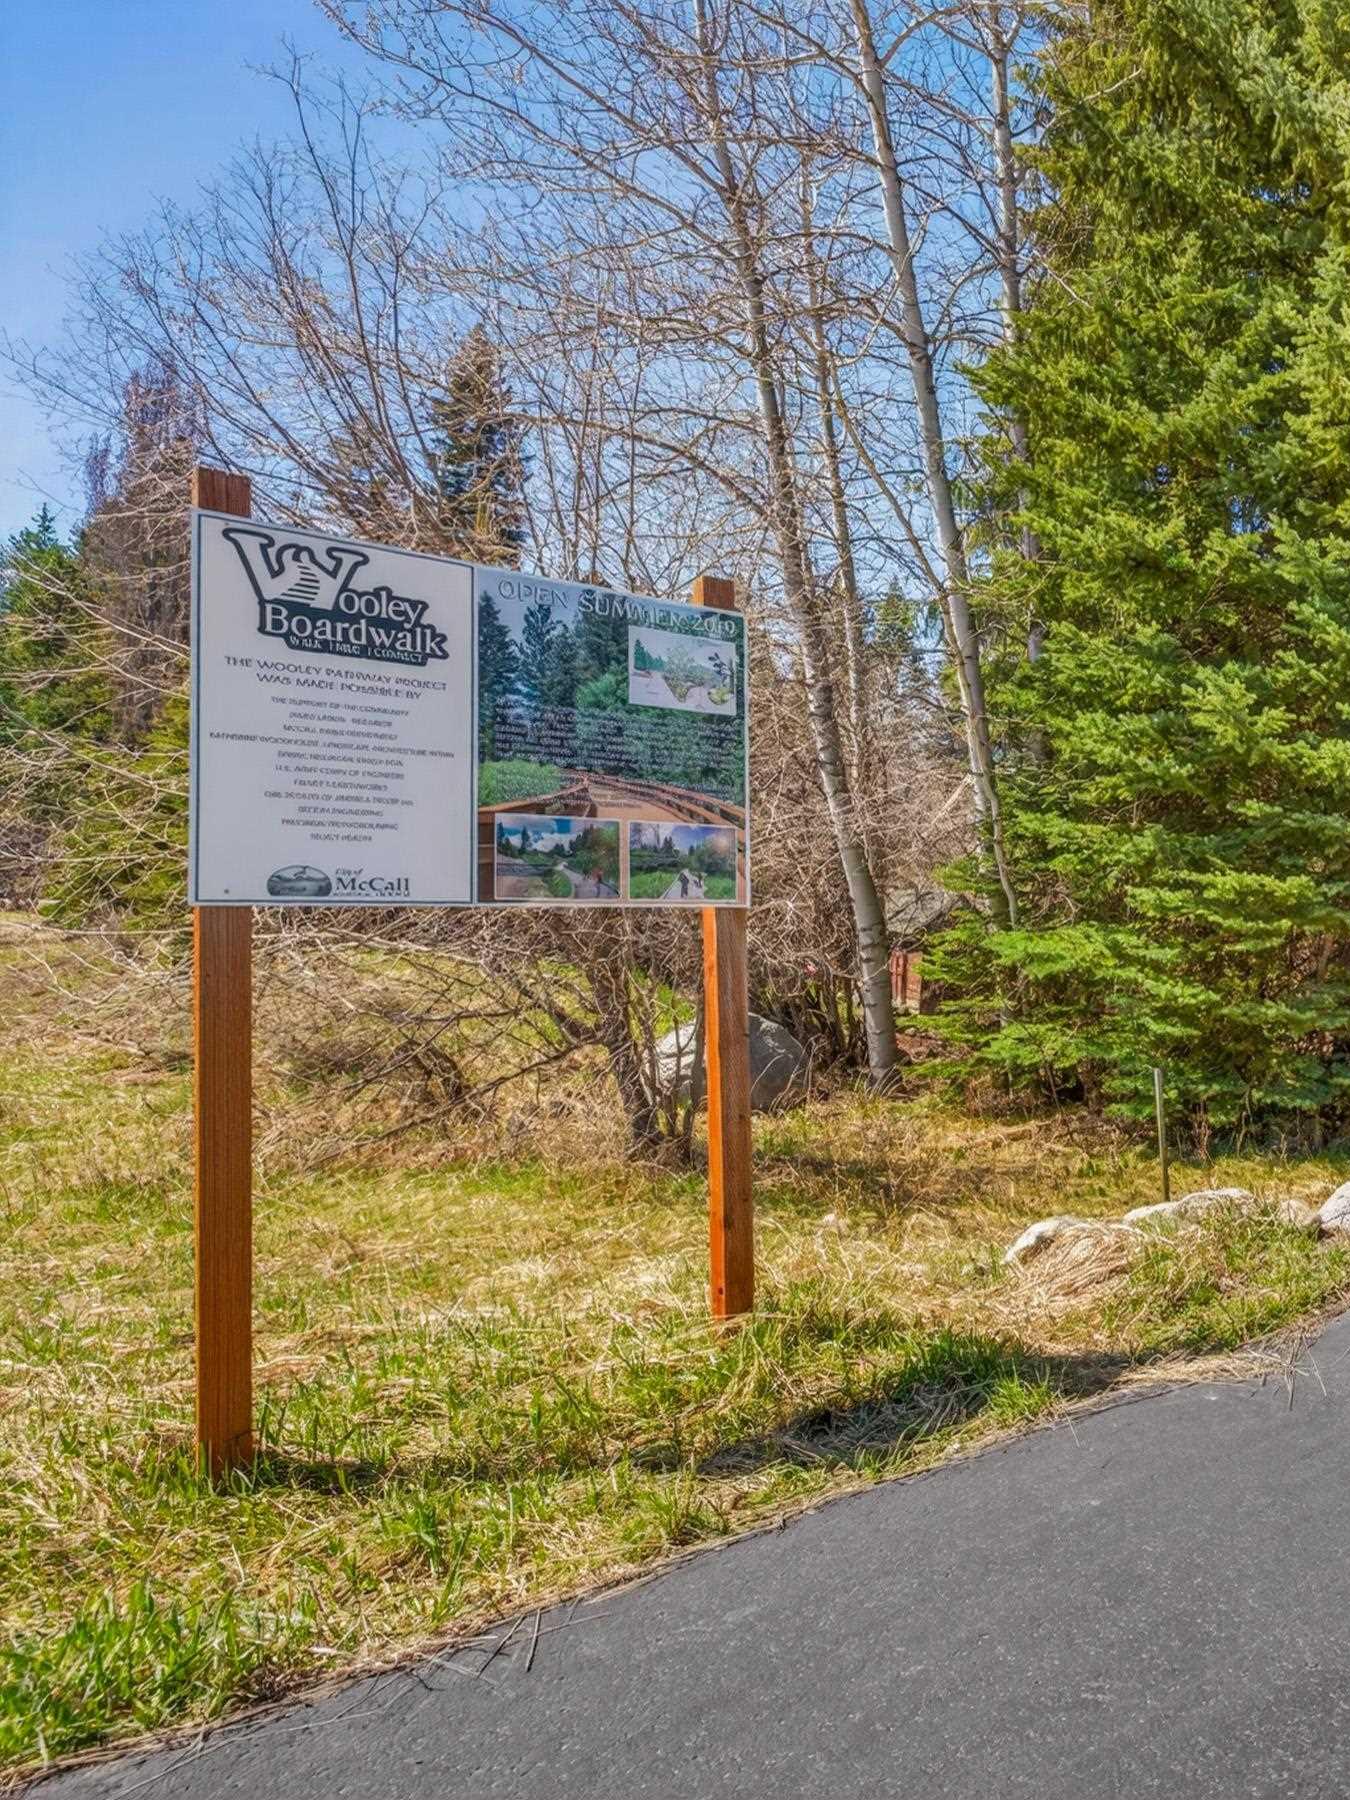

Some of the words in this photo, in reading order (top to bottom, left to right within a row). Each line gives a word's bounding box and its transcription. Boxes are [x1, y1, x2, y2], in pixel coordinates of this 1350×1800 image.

[222, 527, 424, 630] Wooley
[498, 579, 569, 609] OPEN
[264, 602, 447, 657] Boardwalk
[224, 655, 253, 668] THE
[256, 659, 323, 676] WOOLEY
[256, 672, 292, 686] WAS
[295, 677, 335, 691] MADE
[405, 688, 423, 700] BY
[335, 877, 411, 892] McCall
